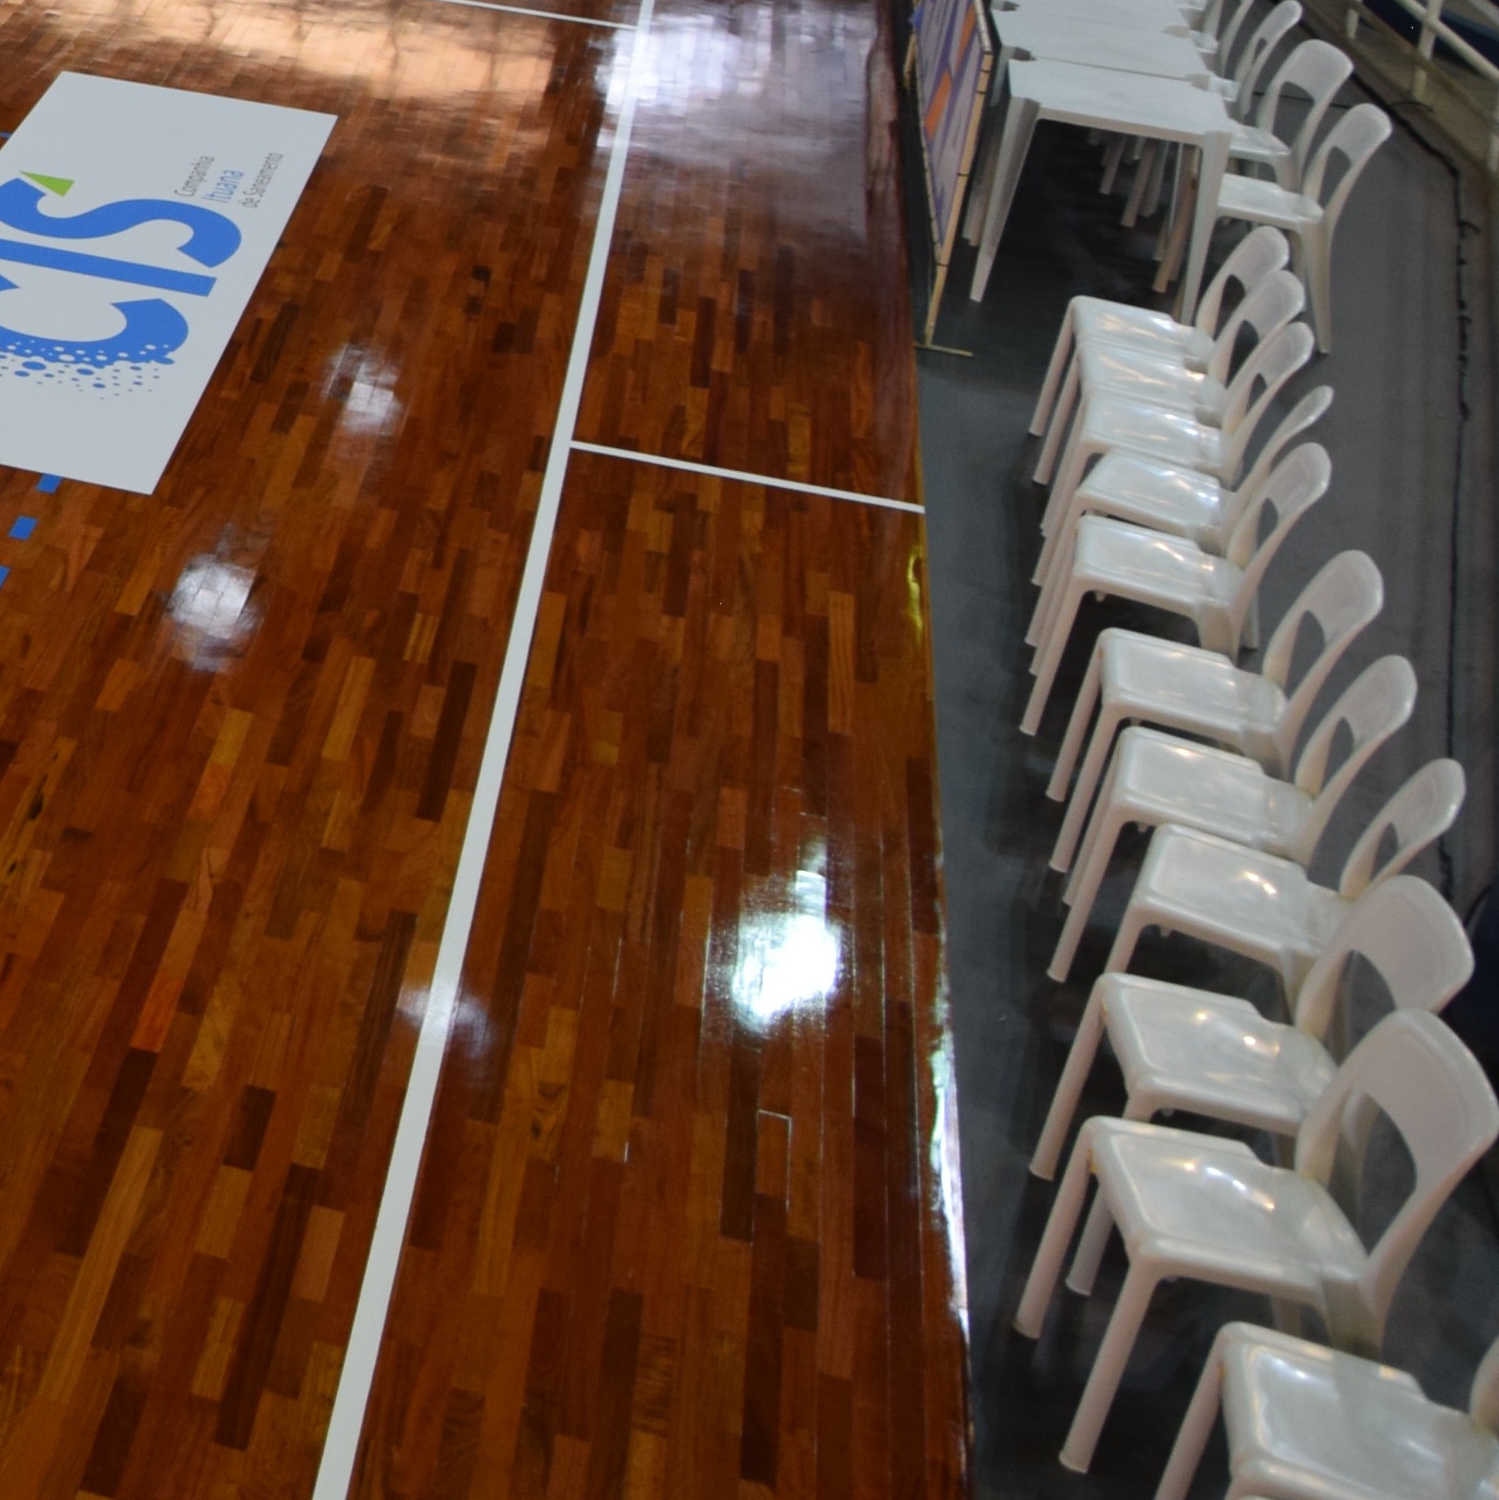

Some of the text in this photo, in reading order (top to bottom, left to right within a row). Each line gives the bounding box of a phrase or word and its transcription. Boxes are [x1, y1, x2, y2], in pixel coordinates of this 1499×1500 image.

[174, 155, 215, 197] Companhia
[200, 169, 244, 203] Ituana
[243, 151, 284, 198] Saneamento
